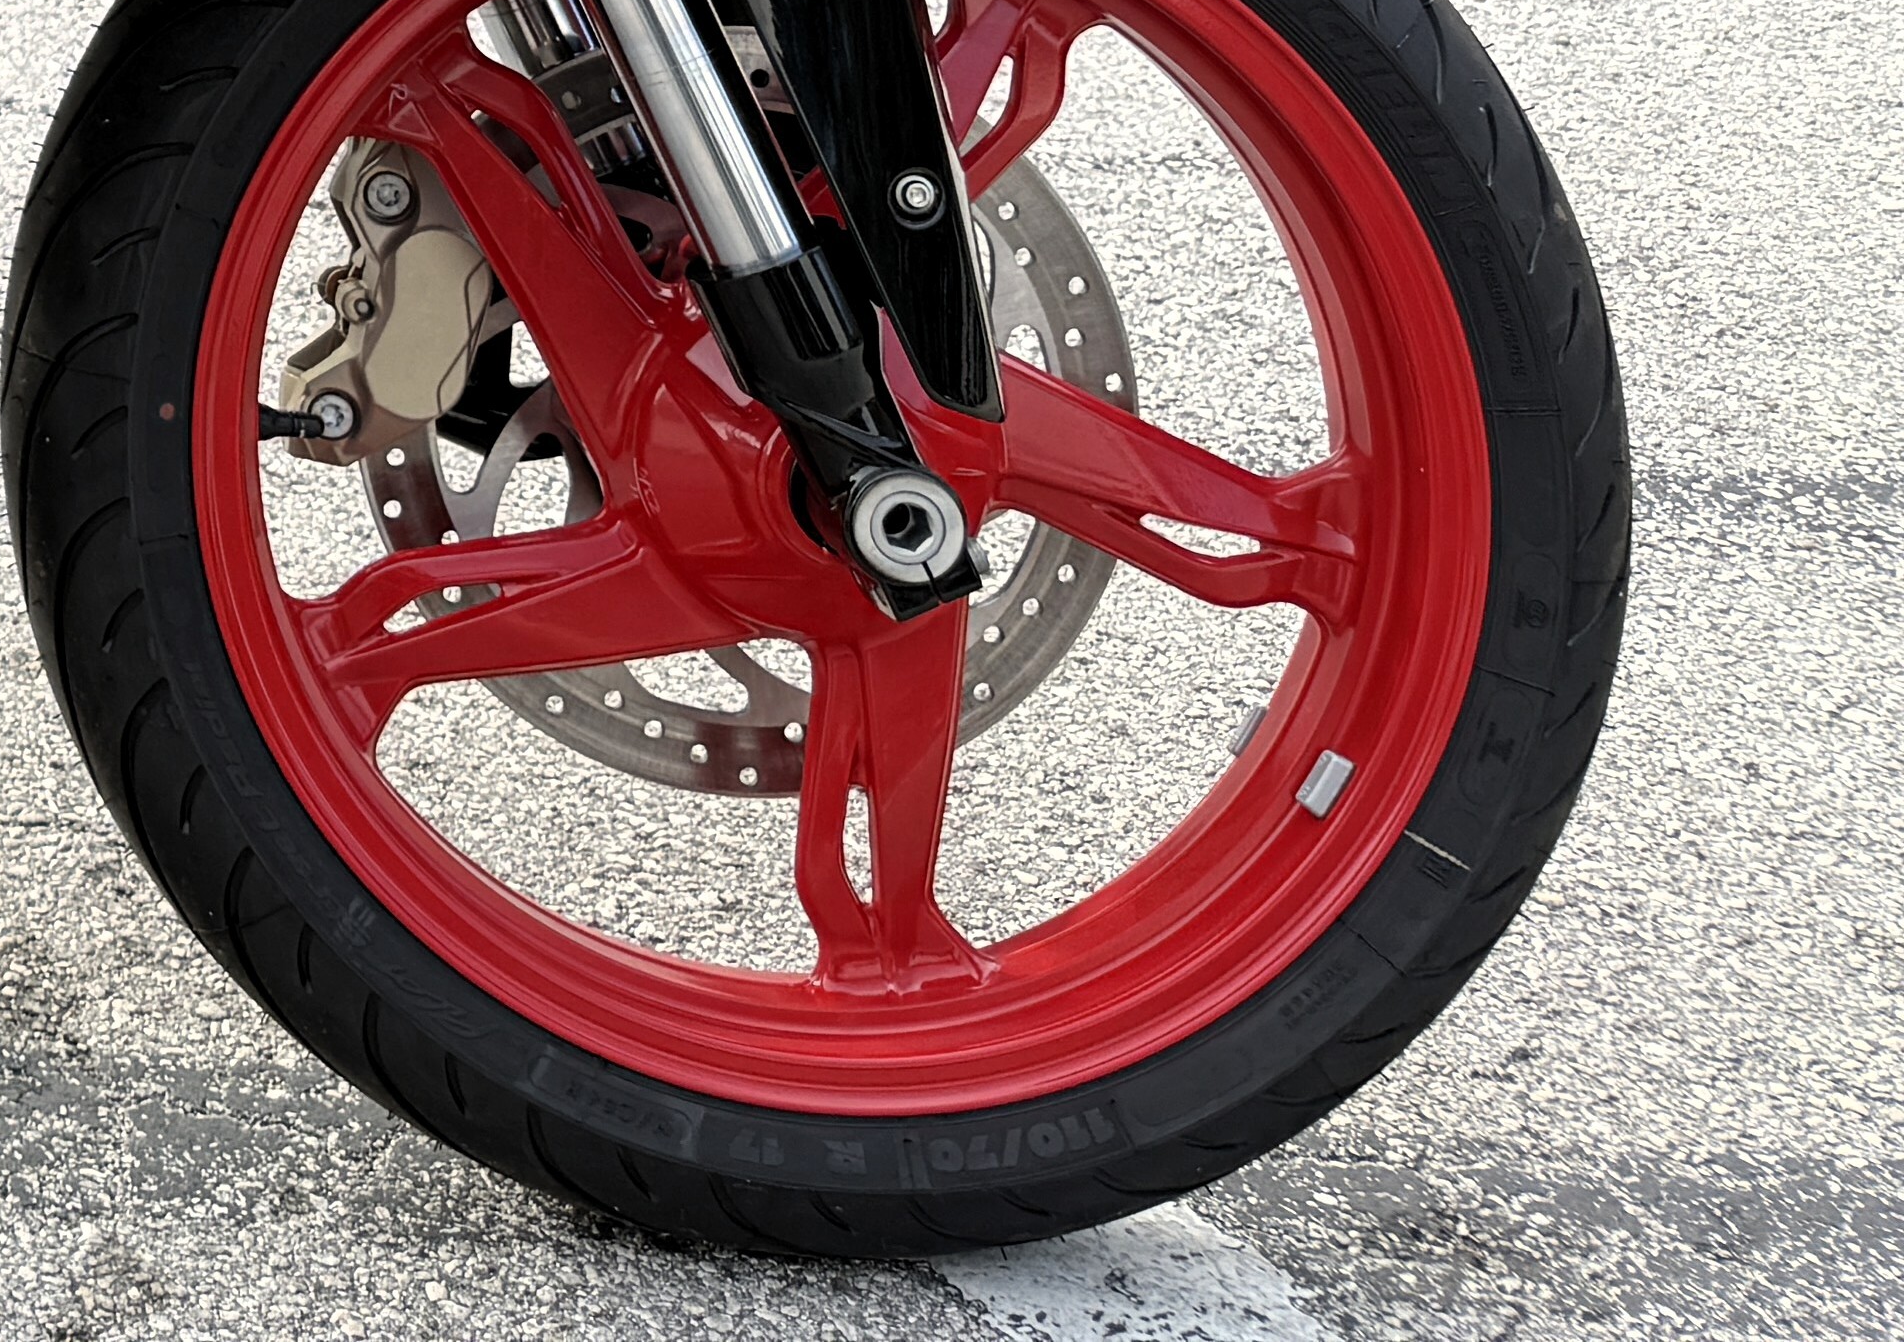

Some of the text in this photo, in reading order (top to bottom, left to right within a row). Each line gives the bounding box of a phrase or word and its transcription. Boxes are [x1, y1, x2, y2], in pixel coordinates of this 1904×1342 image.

[728, 1128, 785, 1165] 17
[822, 1137, 865, 1173] R
[930, 1106, 1117, 1174] 110/70
